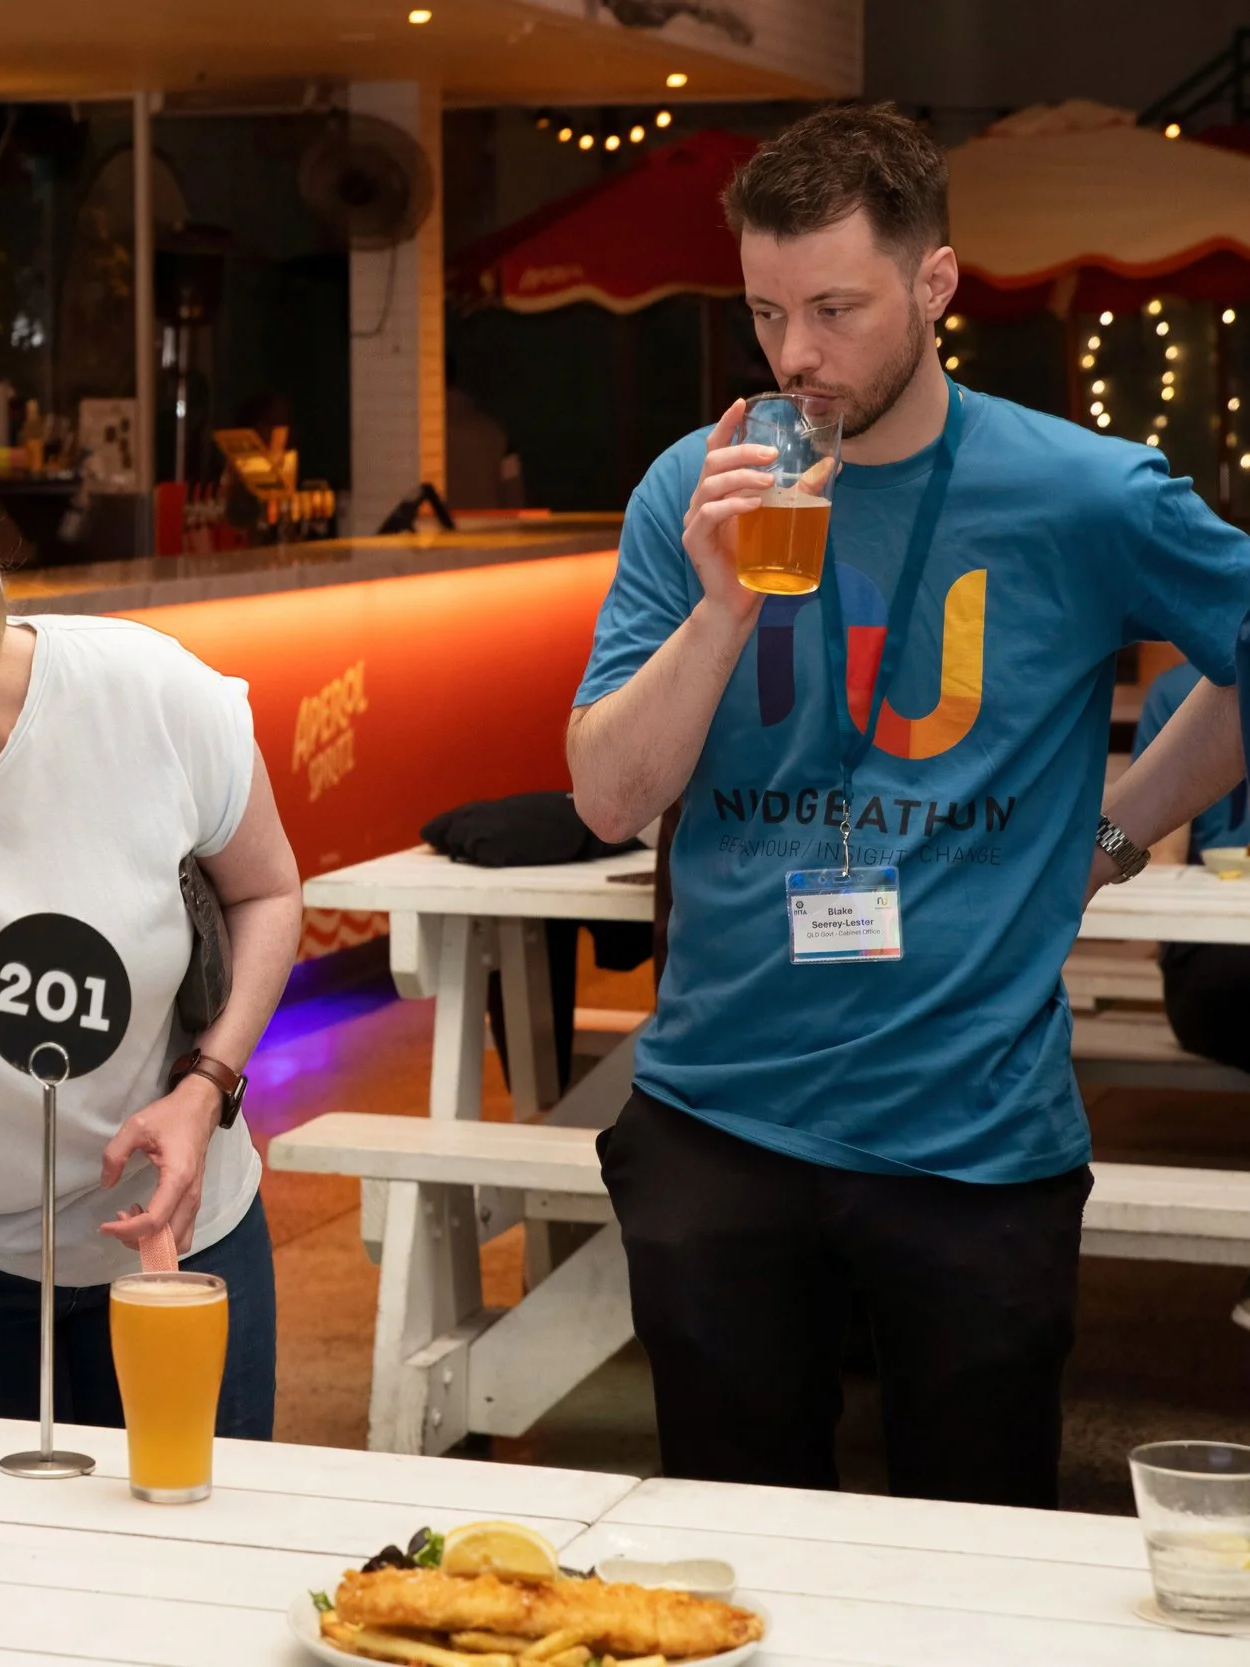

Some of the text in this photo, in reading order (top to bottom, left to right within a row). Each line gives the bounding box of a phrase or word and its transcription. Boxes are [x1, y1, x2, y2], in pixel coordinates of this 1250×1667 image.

[827, 907, 853, 916] Blake
[811, 918, 874, 929] Seerey-Lester
[806, 931, 820, 939] QLD
[838, 929, 862, 937] Cabinet
